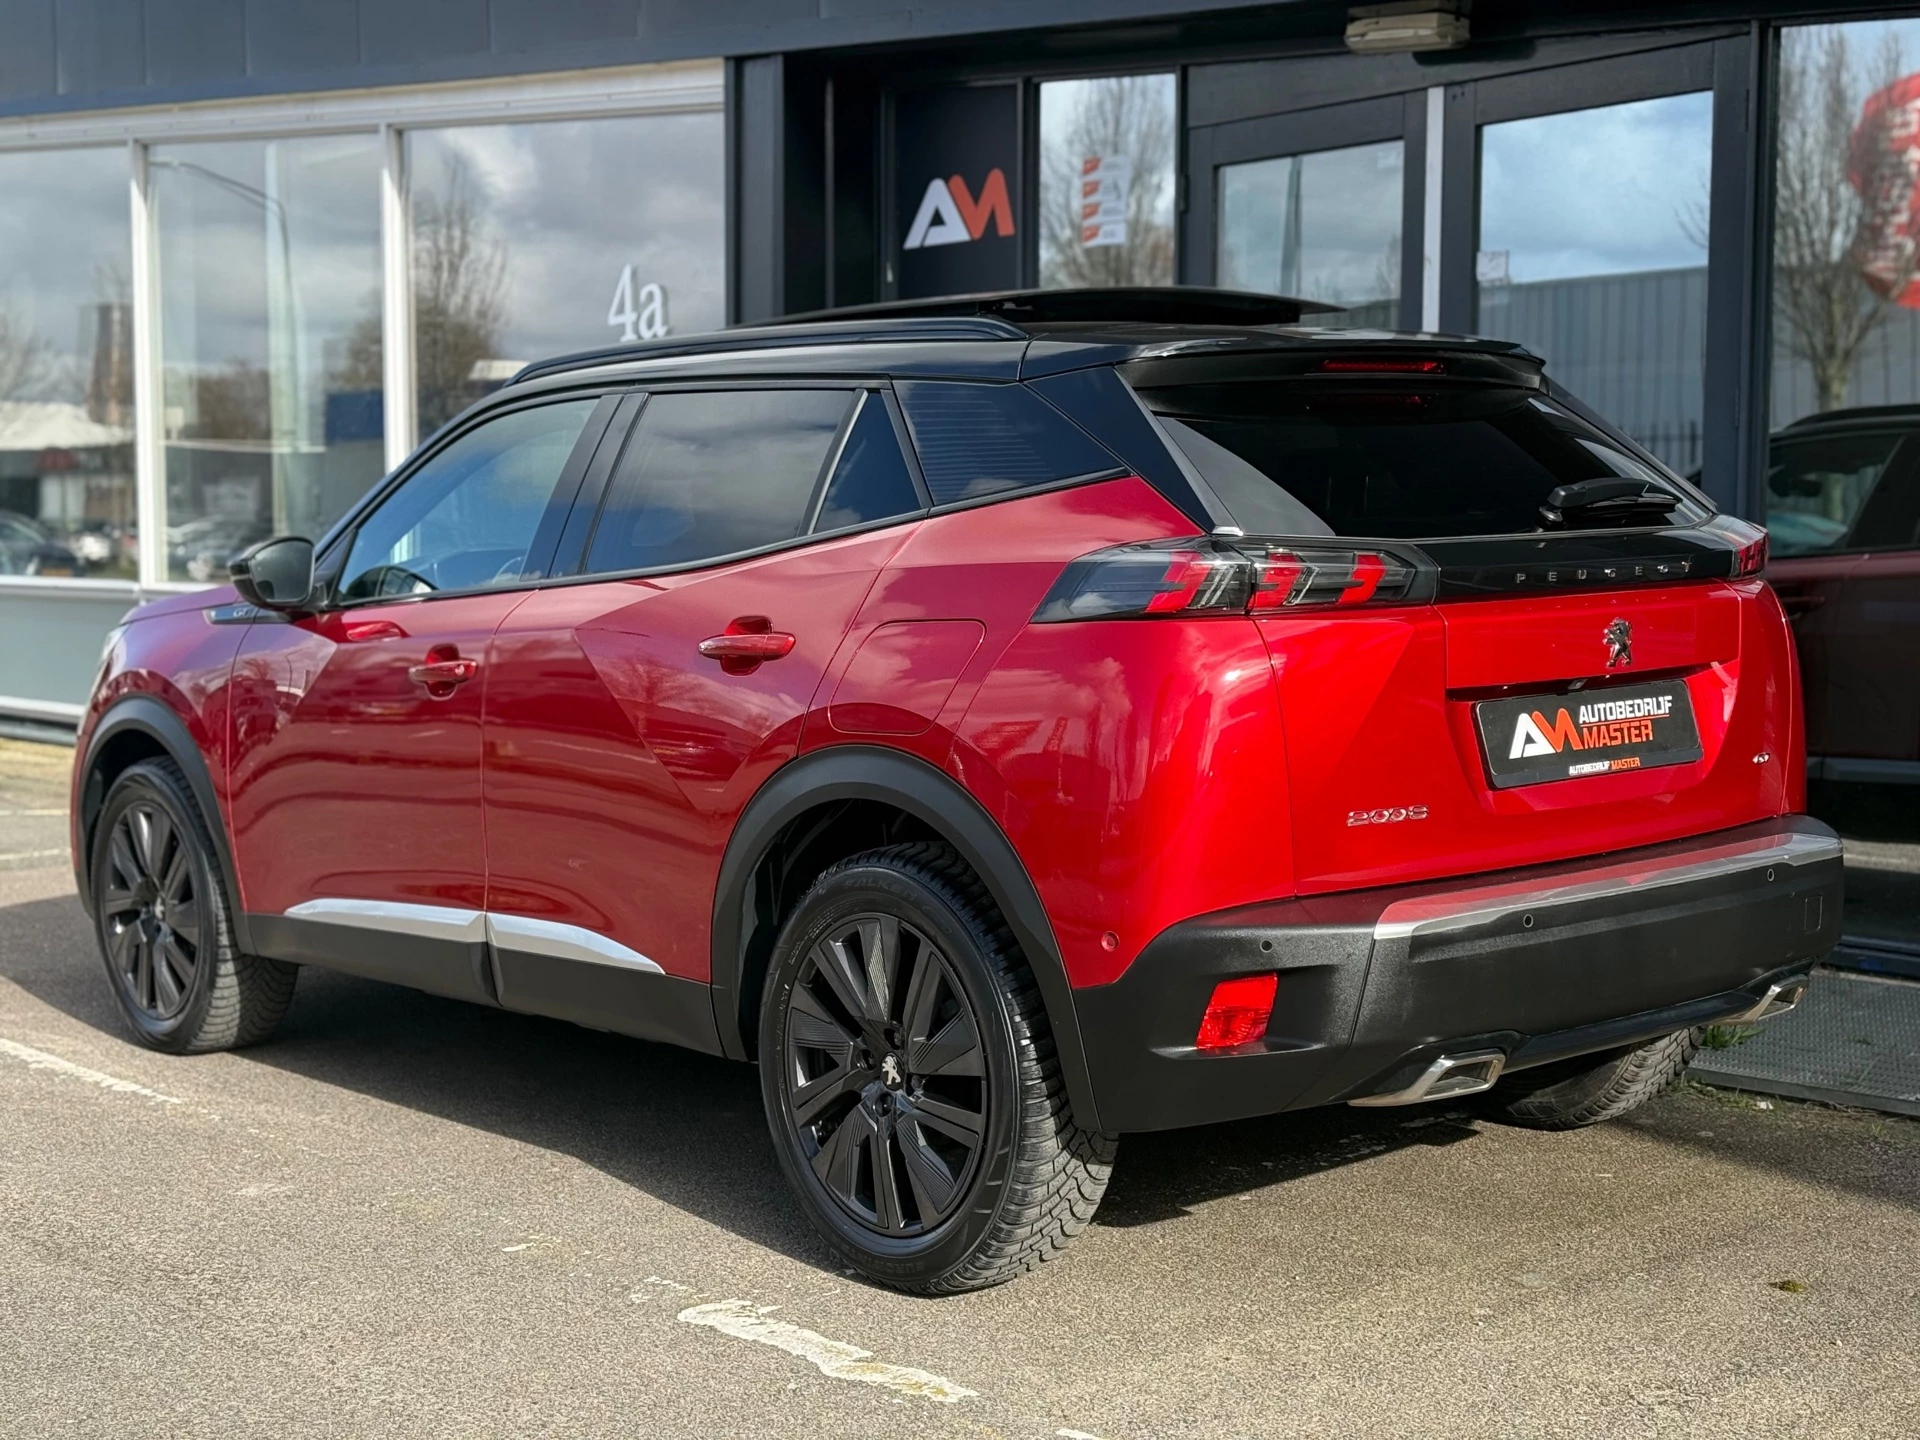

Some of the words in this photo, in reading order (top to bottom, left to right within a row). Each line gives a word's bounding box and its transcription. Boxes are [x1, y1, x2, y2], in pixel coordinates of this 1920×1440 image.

[902, 167, 1016, 250] AM
[607, 263, 668, 342] 4a
[1578, 695, 1673, 724] AUTOBEDRIJF
[1508, 707, 1584, 760] AM
[1582, 719, 1654, 750] MASTER
[1611, 756, 1641, 770] MASTER
